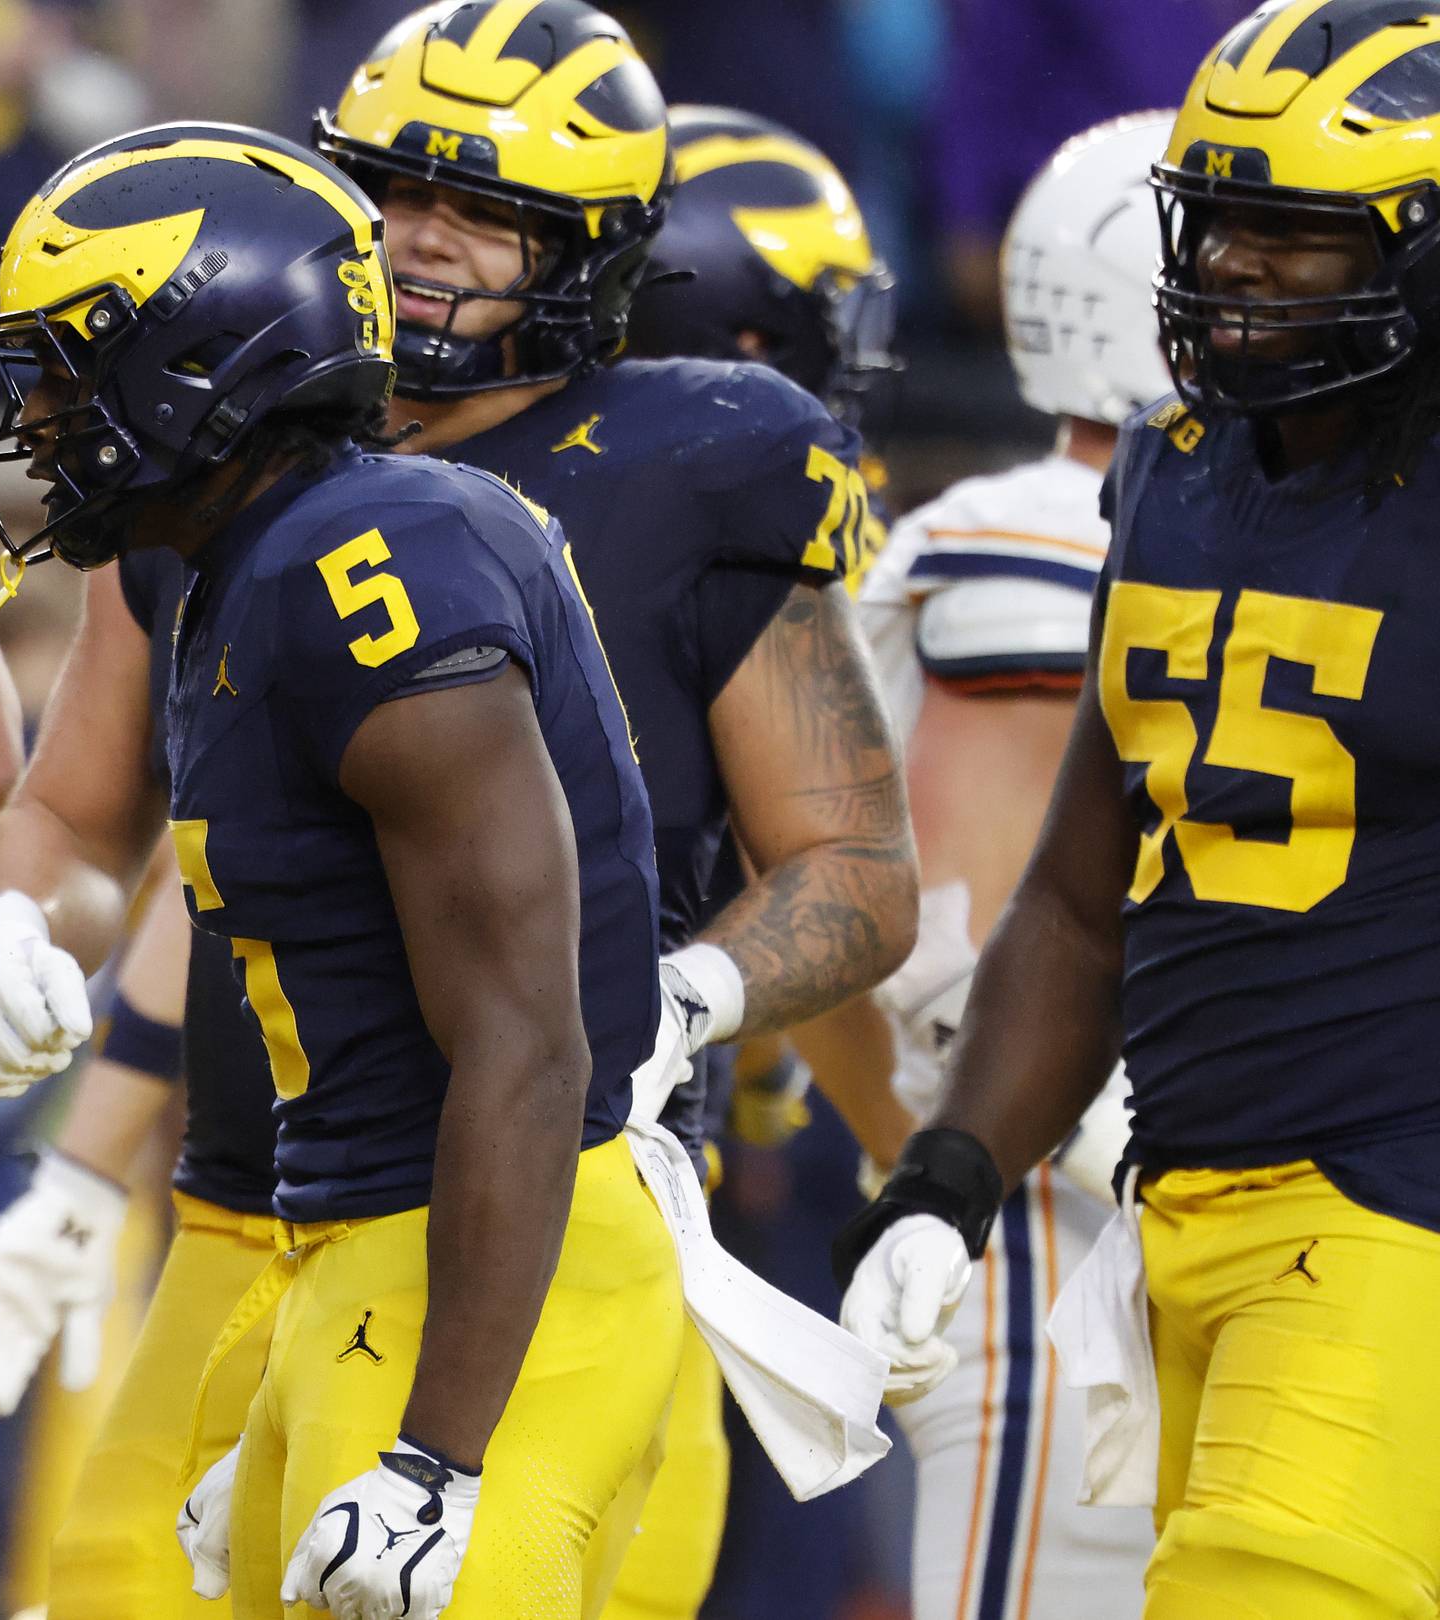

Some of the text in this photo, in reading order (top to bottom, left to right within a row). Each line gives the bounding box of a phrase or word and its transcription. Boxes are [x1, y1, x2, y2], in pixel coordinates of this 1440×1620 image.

[425, 129, 463, 161] M
[1206, 148, 1234, 178] M
[363, 320, 373, 350] 5
[801, 444, 869, 600] 70
[315, 528, 421, 668] 5
[1099, 581, 1385, 913] 55
